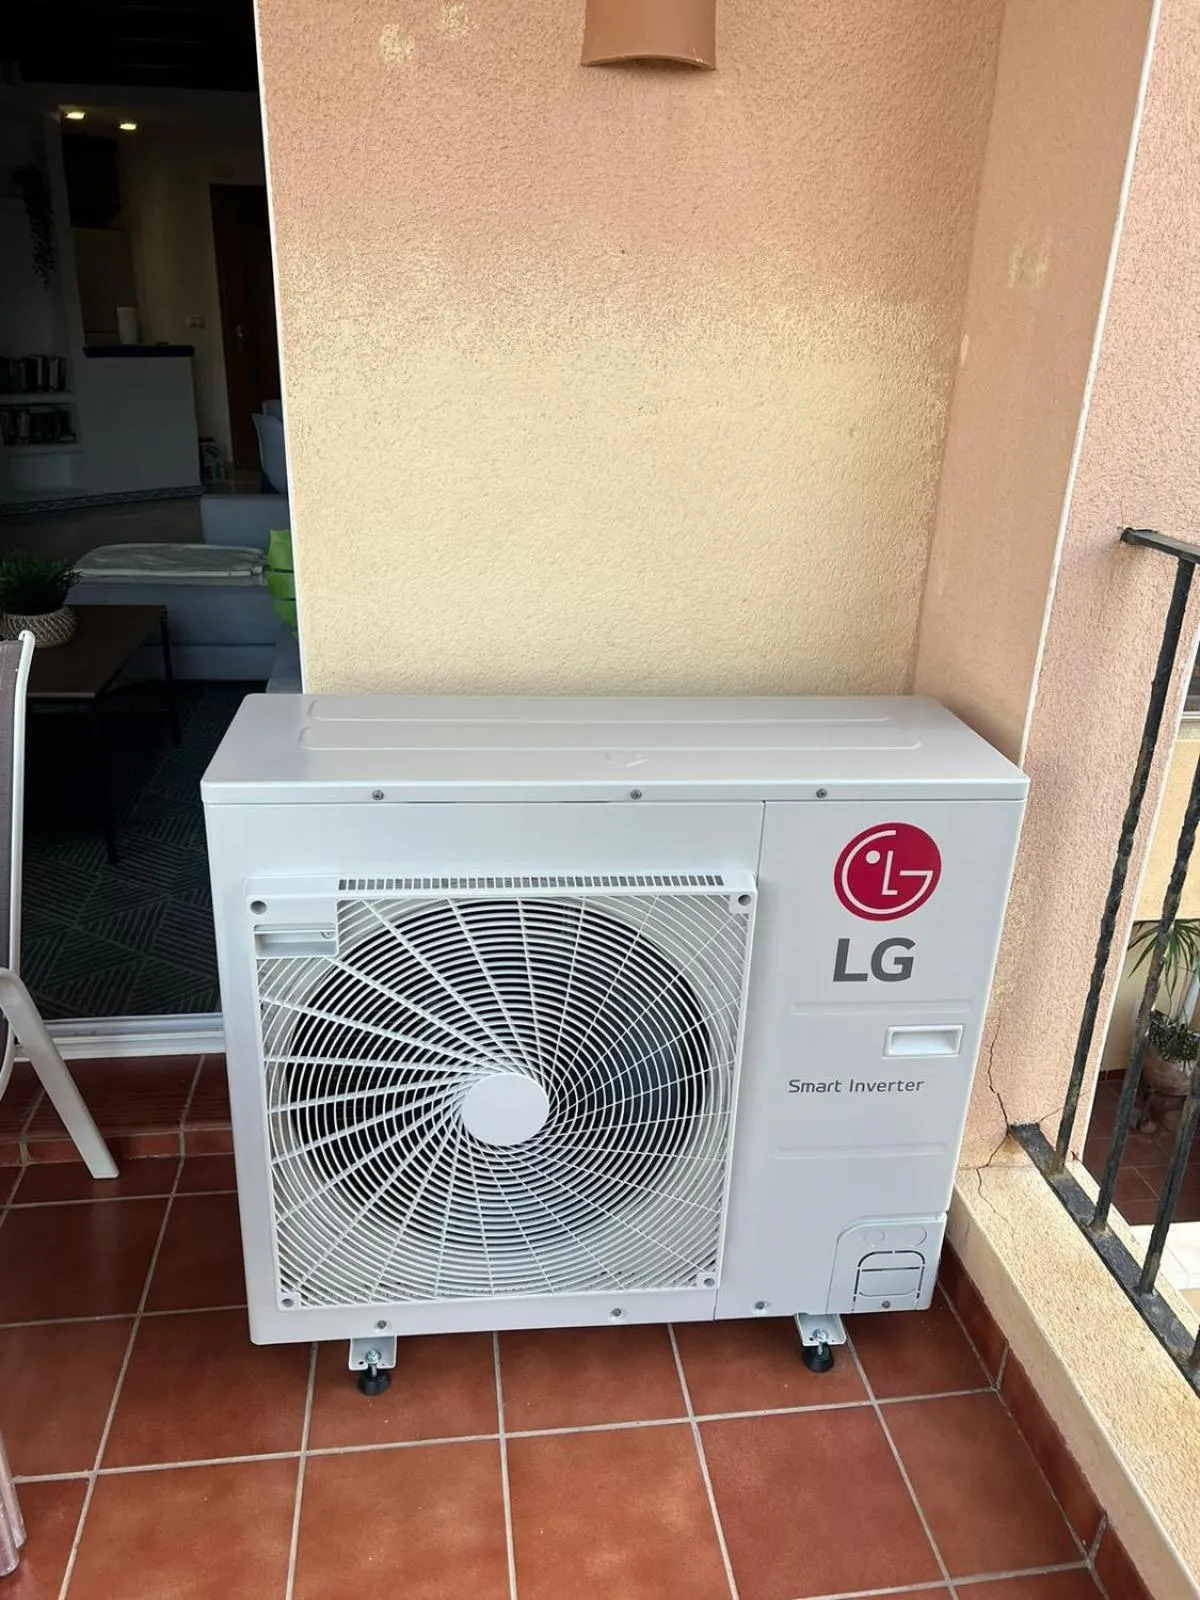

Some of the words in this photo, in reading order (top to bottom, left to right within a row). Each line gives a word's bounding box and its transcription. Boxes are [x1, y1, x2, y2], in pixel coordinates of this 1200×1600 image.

[832, 937, 916, 982] LG
[788, 1079, 842, 1093] Smart
[849, 1079, 924, 1093] Inverter
